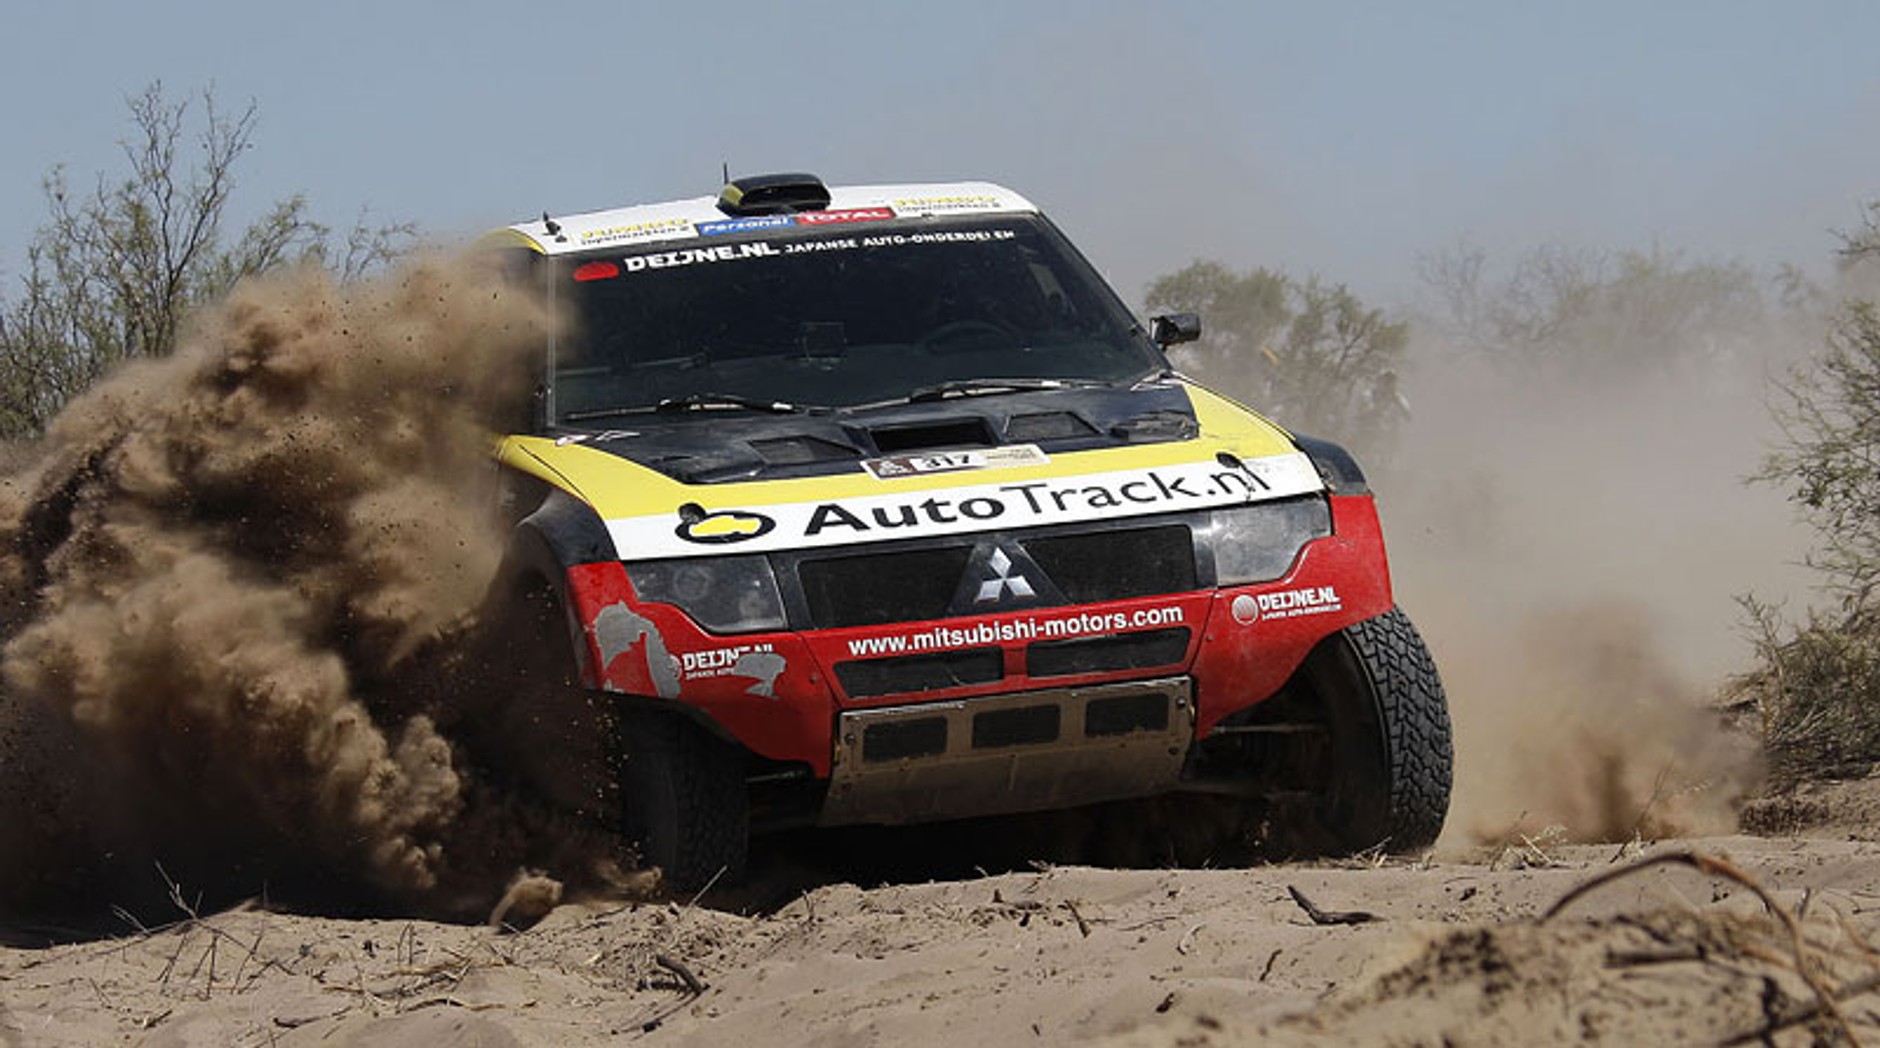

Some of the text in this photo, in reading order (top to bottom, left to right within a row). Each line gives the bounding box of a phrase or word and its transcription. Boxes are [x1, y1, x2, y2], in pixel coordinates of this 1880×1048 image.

[703, 216, 789, 233] Personal
[802, 209, 890, 223] TOTAL
[624, 242, 780, 272] DEIJNE.NL
[784, 239, 859, 254] JAPANSE
[804, 462, 1270, 537] AutoTrack.nl
[1257, 586, 1341, 612] DEIJNE.NL
[849, 605, 1184, 656] www.mitsubishi-motors.com
